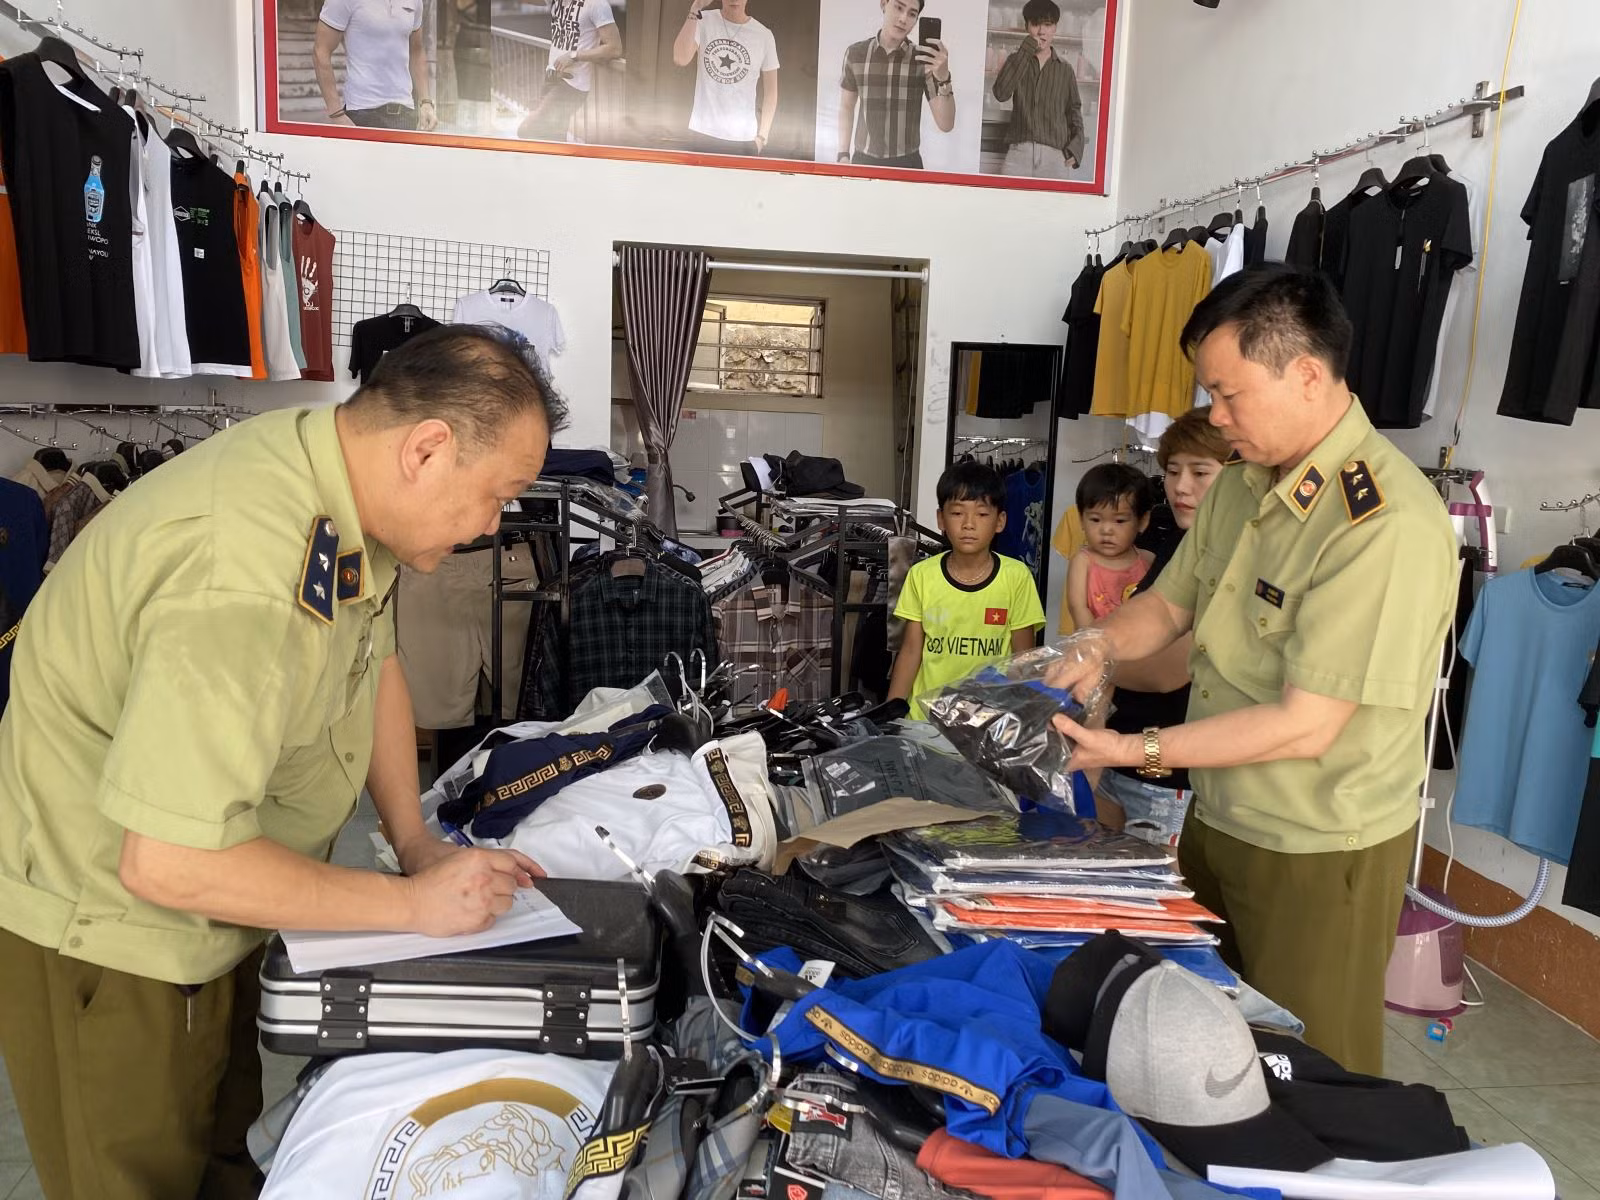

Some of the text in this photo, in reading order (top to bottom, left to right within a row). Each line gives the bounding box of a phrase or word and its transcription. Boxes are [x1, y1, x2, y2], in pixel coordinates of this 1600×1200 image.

[947, 636, 1004, 656] VIETNAM
[839, 1030, 870, 1056] adidas
[921, 1070, 959, 1088] adidas
